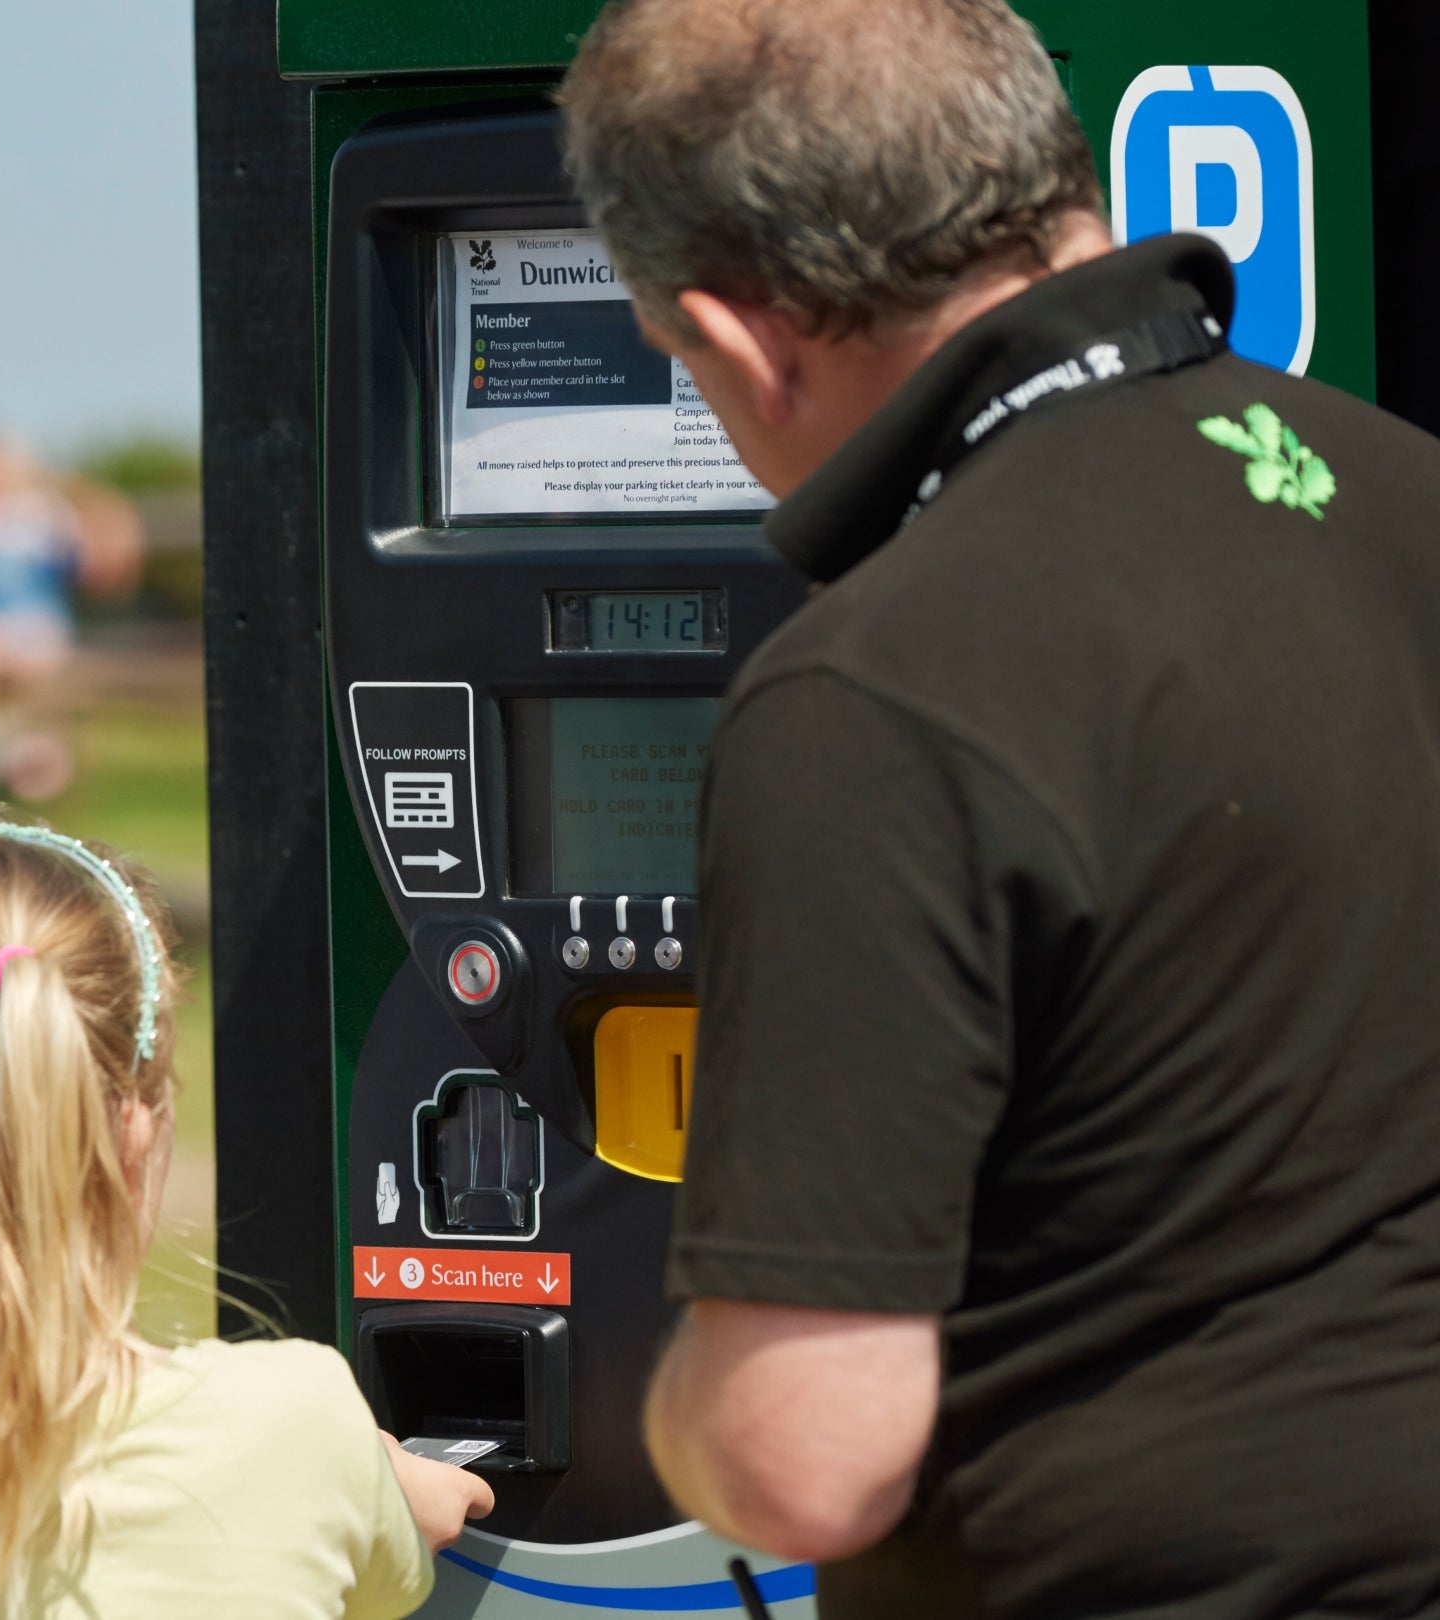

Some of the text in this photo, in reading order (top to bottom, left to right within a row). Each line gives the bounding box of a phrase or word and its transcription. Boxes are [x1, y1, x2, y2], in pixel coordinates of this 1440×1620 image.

[1169, 125, 1264, 263] P
[517, 239, 574, 250] Welcome to
[471, 277, 501, 286] National
[471, 287, 489, 296] Trust
[476, 313, 531, 329] Member
[490, 340, 510, 350] Press
[512, 341, 536, 352] green
[537, 339, 565, 350] button
[489, 358, 510, 368] Press
[512, 358, 537, 370] yellow
[538, 356, 572, 367] member
[573, 356, 602, 366] button
[488, 376, 509, 387] Place
[511, 378, 529, 388] your
[530, 375, 564, 386] member
[565, 374, 585, 385] card
[585, 374, 594, 384] in
[595, 374, 609, 384] the
[610, 374, 625, 384] slot
[487, 390, 550, 400] below as shown
[674, 421, 715, 432] Coaches:
[673, 436, 691, 446] Join
[693, 436, 717, 447] today
[477, 460, 488, 470] All
[489, 462, 515, 471] money
[517, 459, 541, 469] raised
[543, 459, 565, 470] helps
[566, 460, 576, 468] to
[577, 460, 608, 470] protect
[610, 458, 626, 467] and
[628, 460, 665, 469] preserve
[666, 458, 682, 467] this
[684, 457, 721, 468] precious
[544, 481, 571, 491] Please
[573, 481, 602, 492] display
[604, 482, 624, 492] your
[625, 480, 658, 491] parking
[660, 480, 684, 489] ticket
[686, 480, 714, 490] clearly
[716, 480, 724, 489] in
[726, 481, 747, 490] your
[635, 494, 669, 503] overnight
[670, 494, 697, 503] parking
[608, 600, 699, 642] 14:12
[365, 748, 467, 760] FOLLOW PROMPTS
[581, 744, 640, 760] PLEASE
[648, 743, 688, 759] SCAN
[610, 767, 648, 782] CARD
[559, 799, 598, 814] HOLD
[607, 799, 645, 813] CARD
[655, 799, 674, 813] IN
[431, 1263, 477, 1286] Scan
[481, 1265, 523, 1288] here
